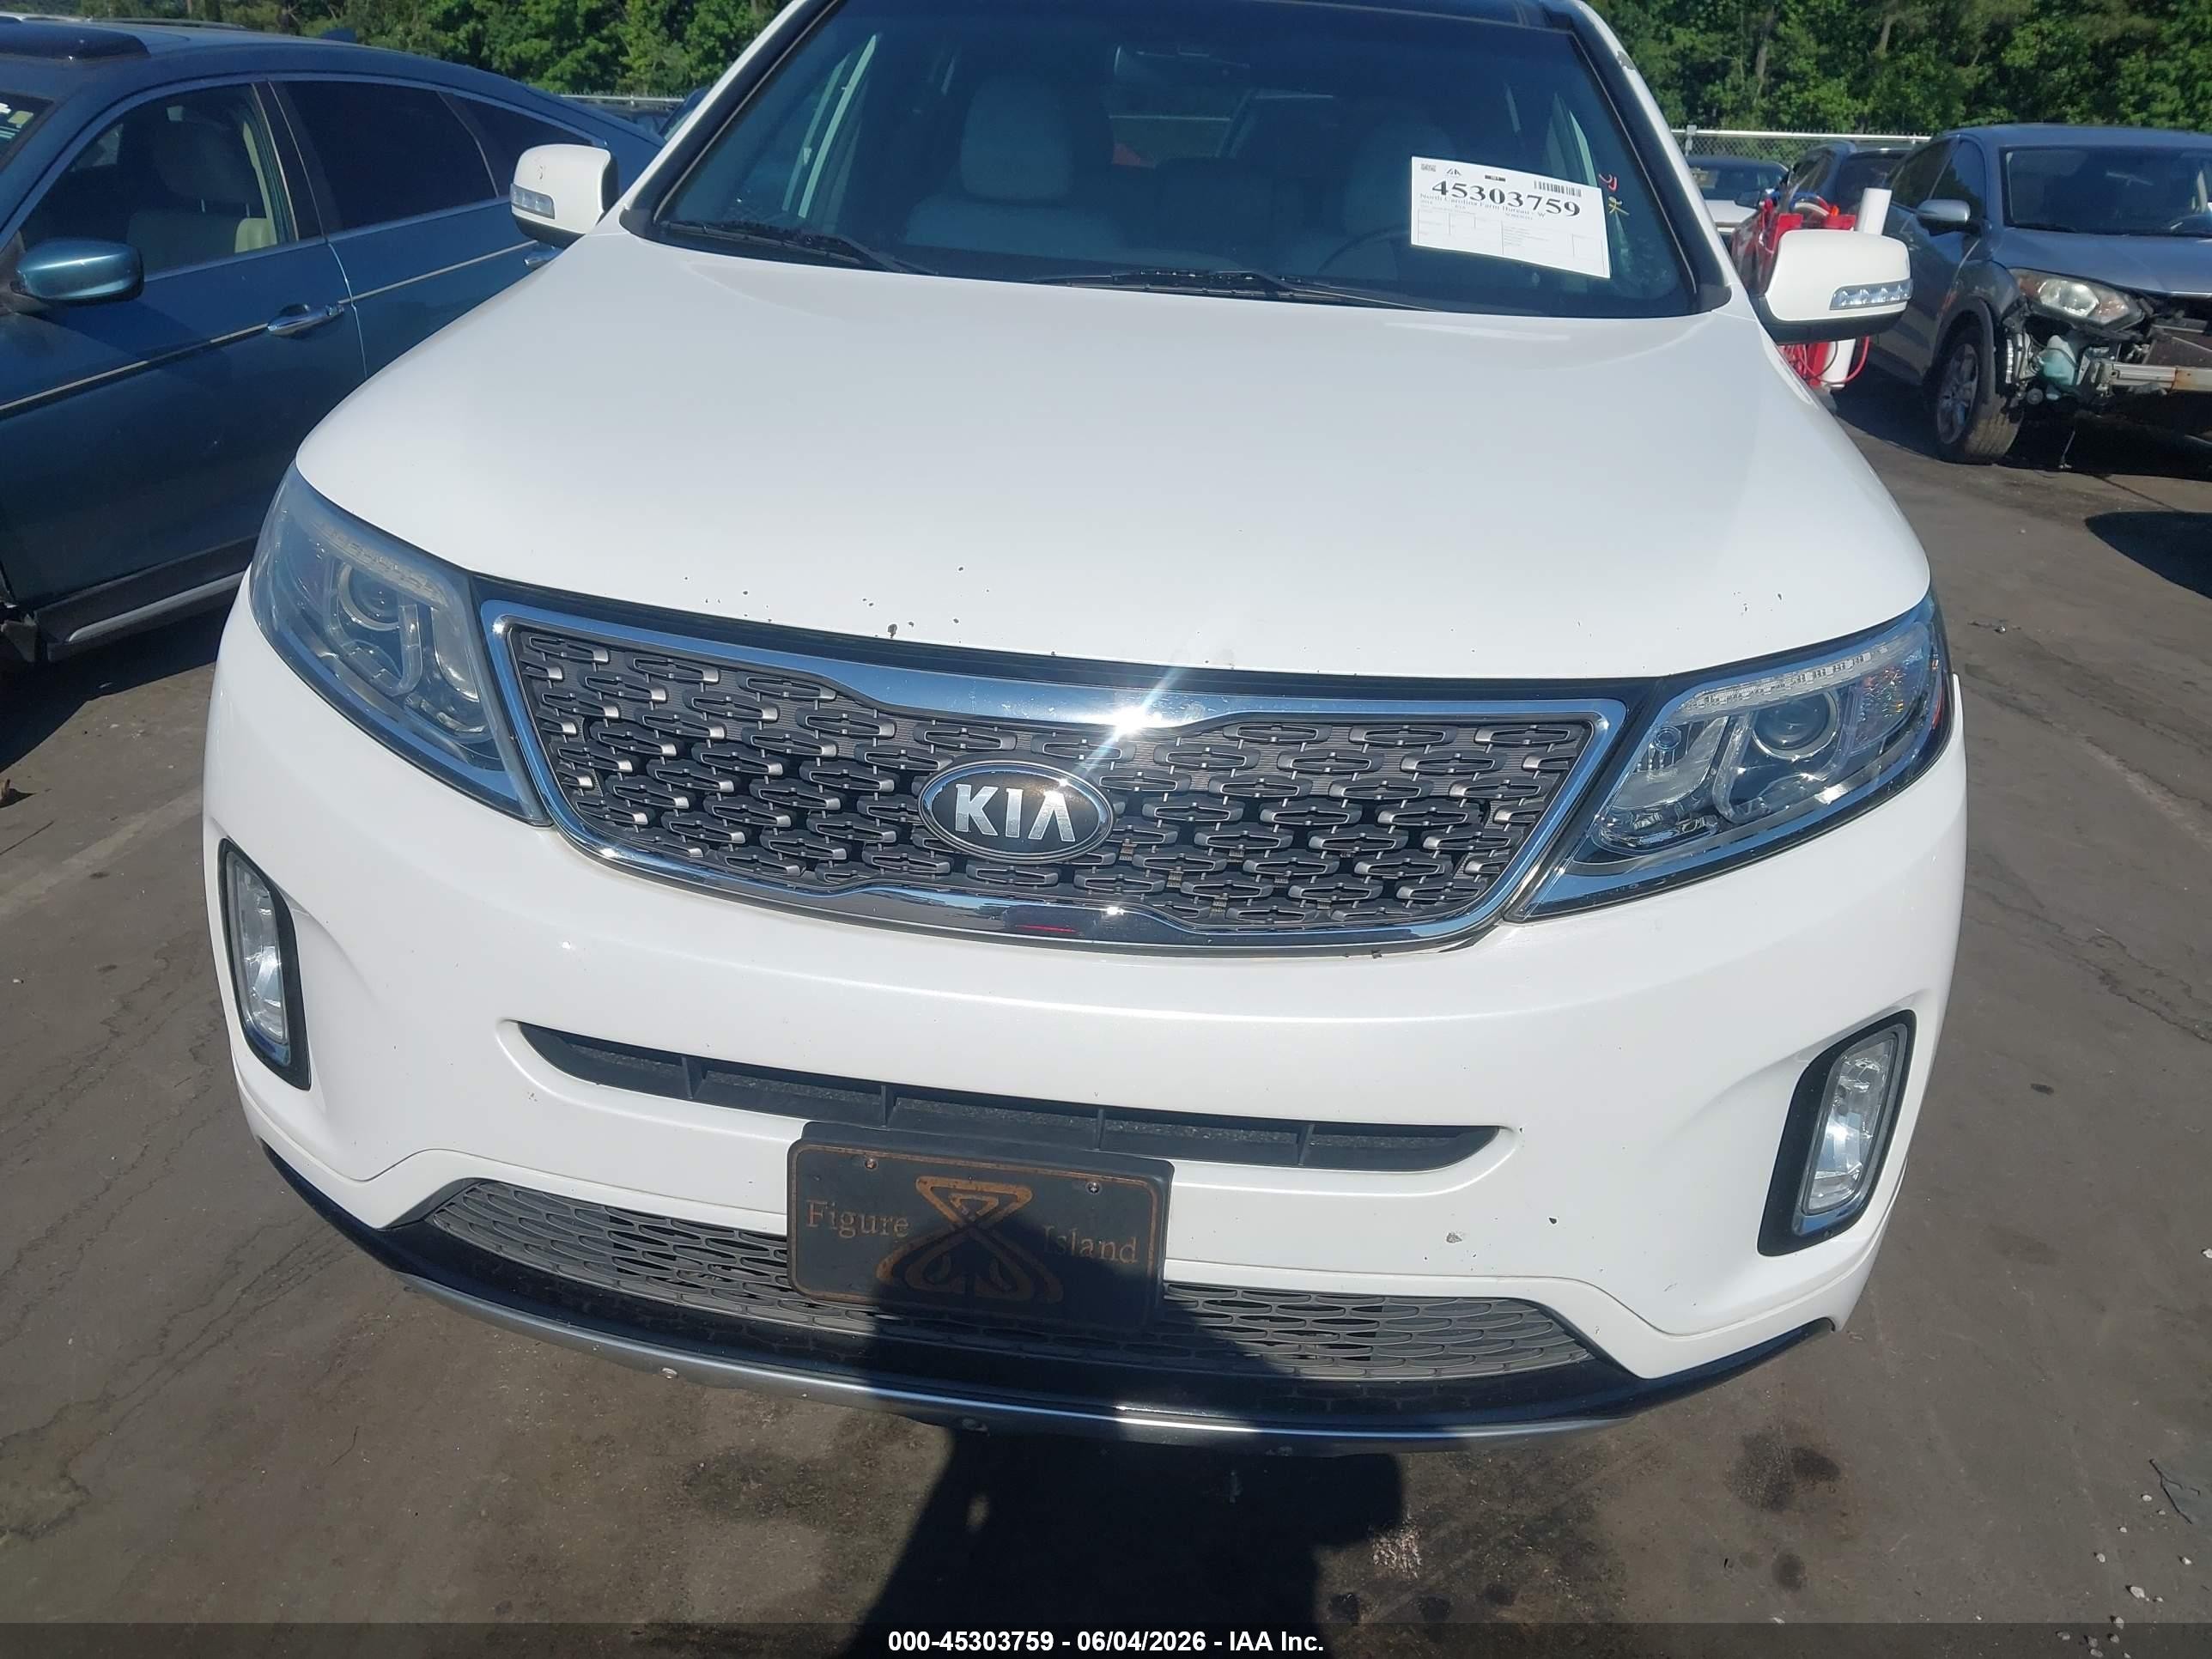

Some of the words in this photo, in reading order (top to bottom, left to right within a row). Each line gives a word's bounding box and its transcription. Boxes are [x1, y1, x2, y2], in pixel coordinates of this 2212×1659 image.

[1431, 179, 1581, 216] 45303759
[955, 784, 1075, 842] KIA
[805, 1200, 911, 1239] Figure
[1043, 1224, 1139, 1265] Island
